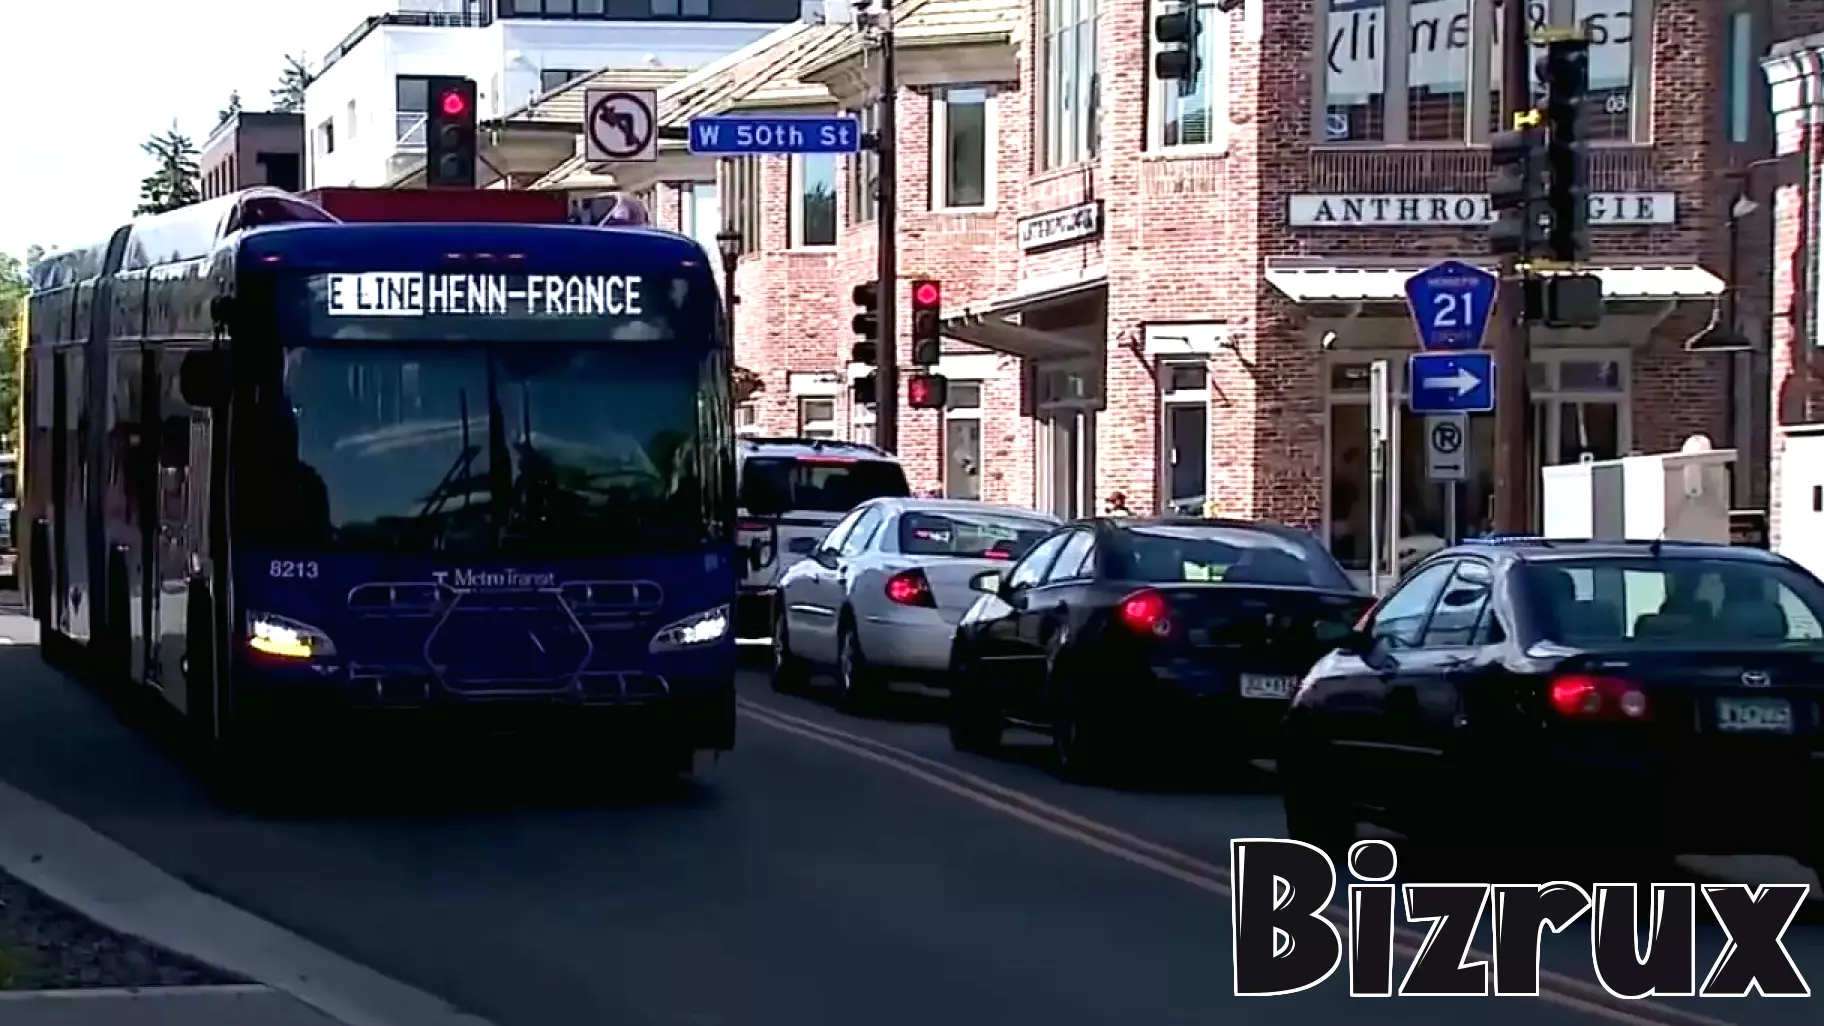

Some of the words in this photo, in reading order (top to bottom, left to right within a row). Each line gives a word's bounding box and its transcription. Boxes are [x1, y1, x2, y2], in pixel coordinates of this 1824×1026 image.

[699, 124, 720, 146] W
[736, 124, 804, 146] 50th
[819, 124, 850, 146] St
[1313, 195, 1655, 221] ANTHROGIE
[331, 277, 344, 310] E
[356, 276, 422, 310] LINE
[428, 274, 643, 315] HENN-FRANCE
[1433, 292, 1473, 328] 21
[269, 559, 319, 579] 8213
